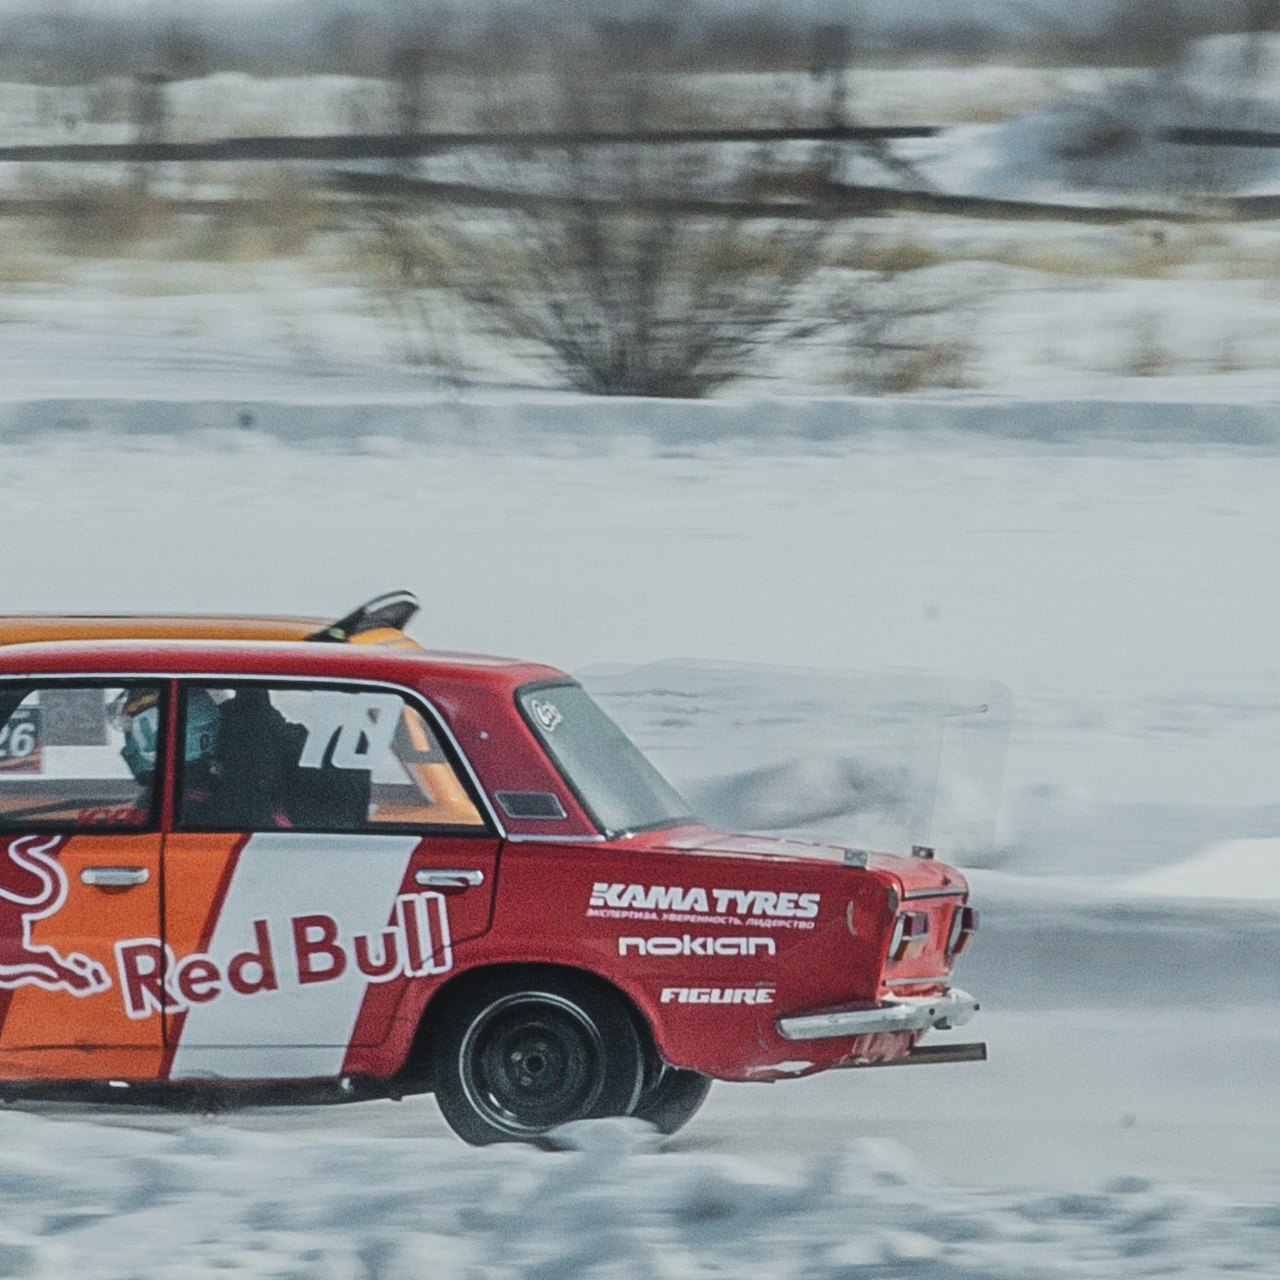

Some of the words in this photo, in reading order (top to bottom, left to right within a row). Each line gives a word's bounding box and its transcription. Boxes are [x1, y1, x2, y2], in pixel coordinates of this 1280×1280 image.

[589, 882, 710, 912] KAMA
[712, 888, 821, 918] TYRES
[116, 918, 280, 1017] Red
[290, 893, 451, 984] Bull
[660, 987, 777, 1005] FIGURE
